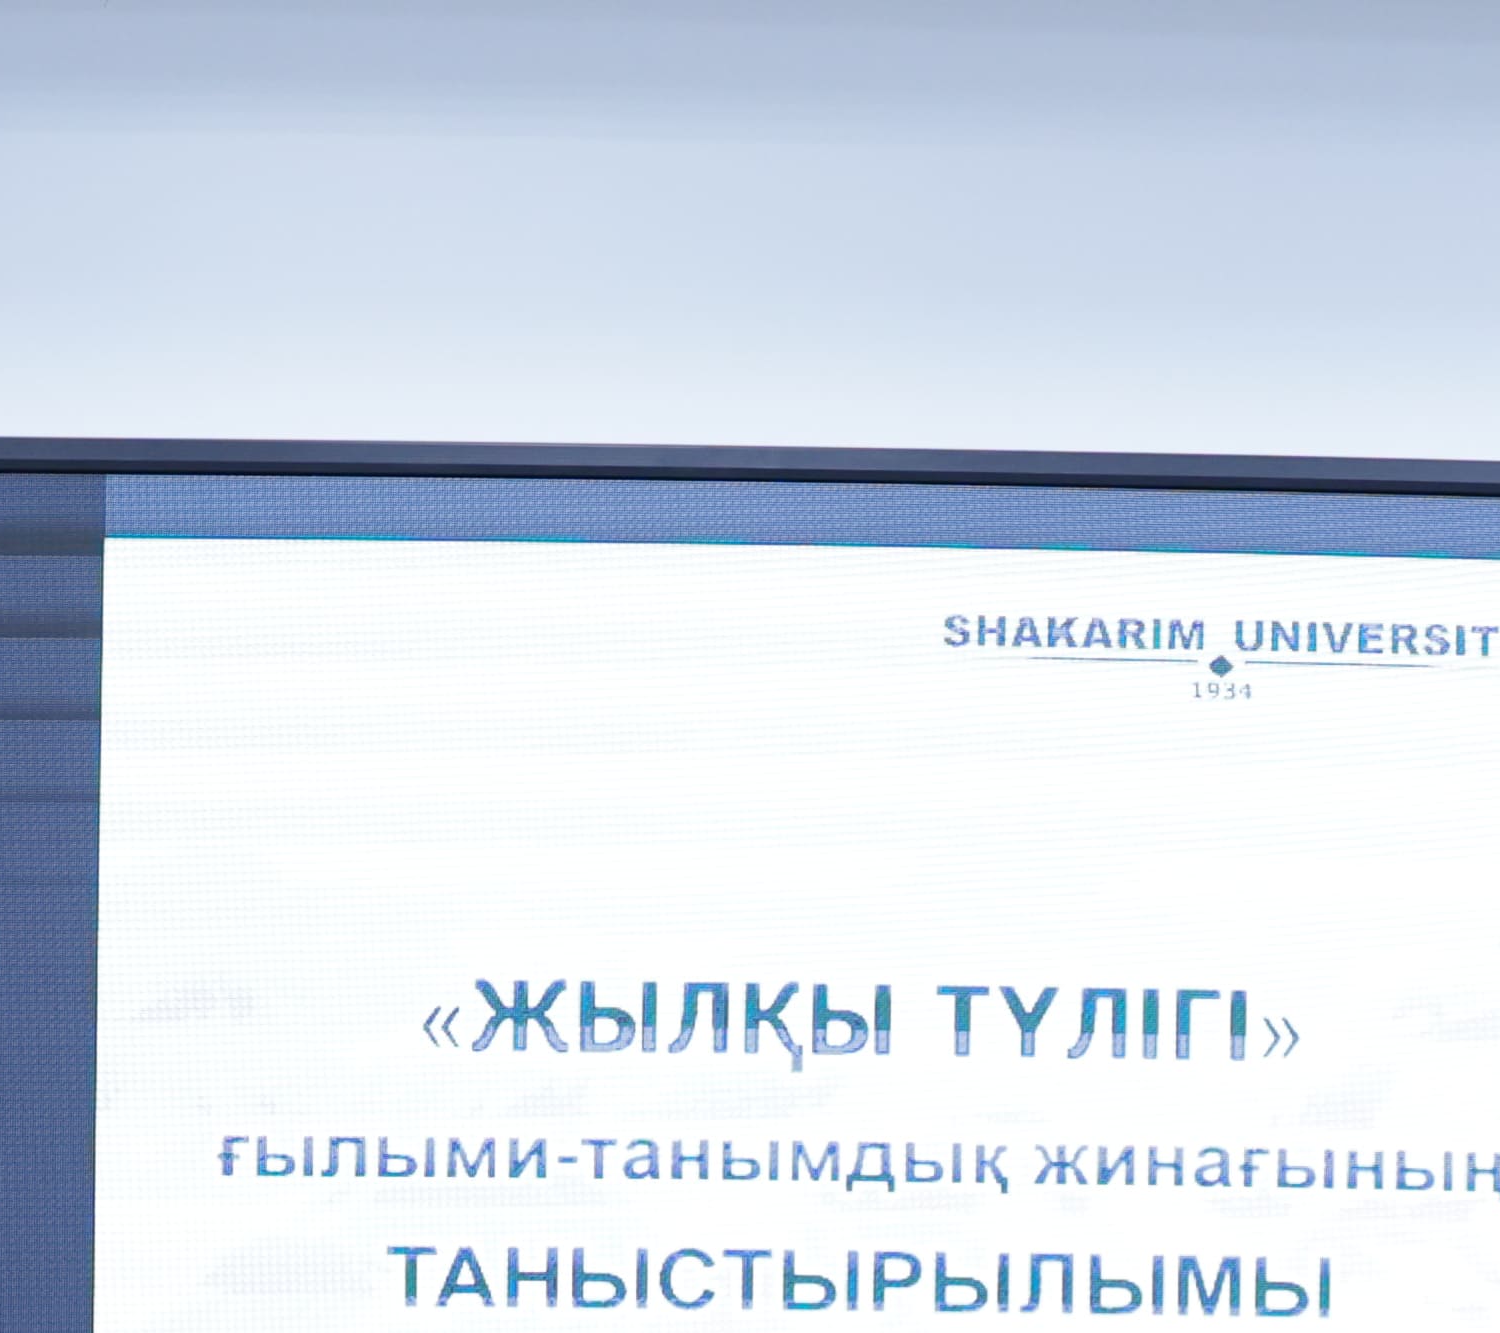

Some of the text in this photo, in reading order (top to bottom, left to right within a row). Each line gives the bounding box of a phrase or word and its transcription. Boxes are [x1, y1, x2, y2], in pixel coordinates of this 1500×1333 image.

[944, 614, 1204, 651] SHAKARIM
[1191, 681, 1252, 700] 1934
[423, 979, 1300, 1072] «ЖЫЛҚЫ ТҮЛІГІ»
[218, 1135, 1007, 1193] ғылыми-танымдық
[387, 1246, 1330, 1318] ТАНЫСТЫРЫЛЫМЫ
